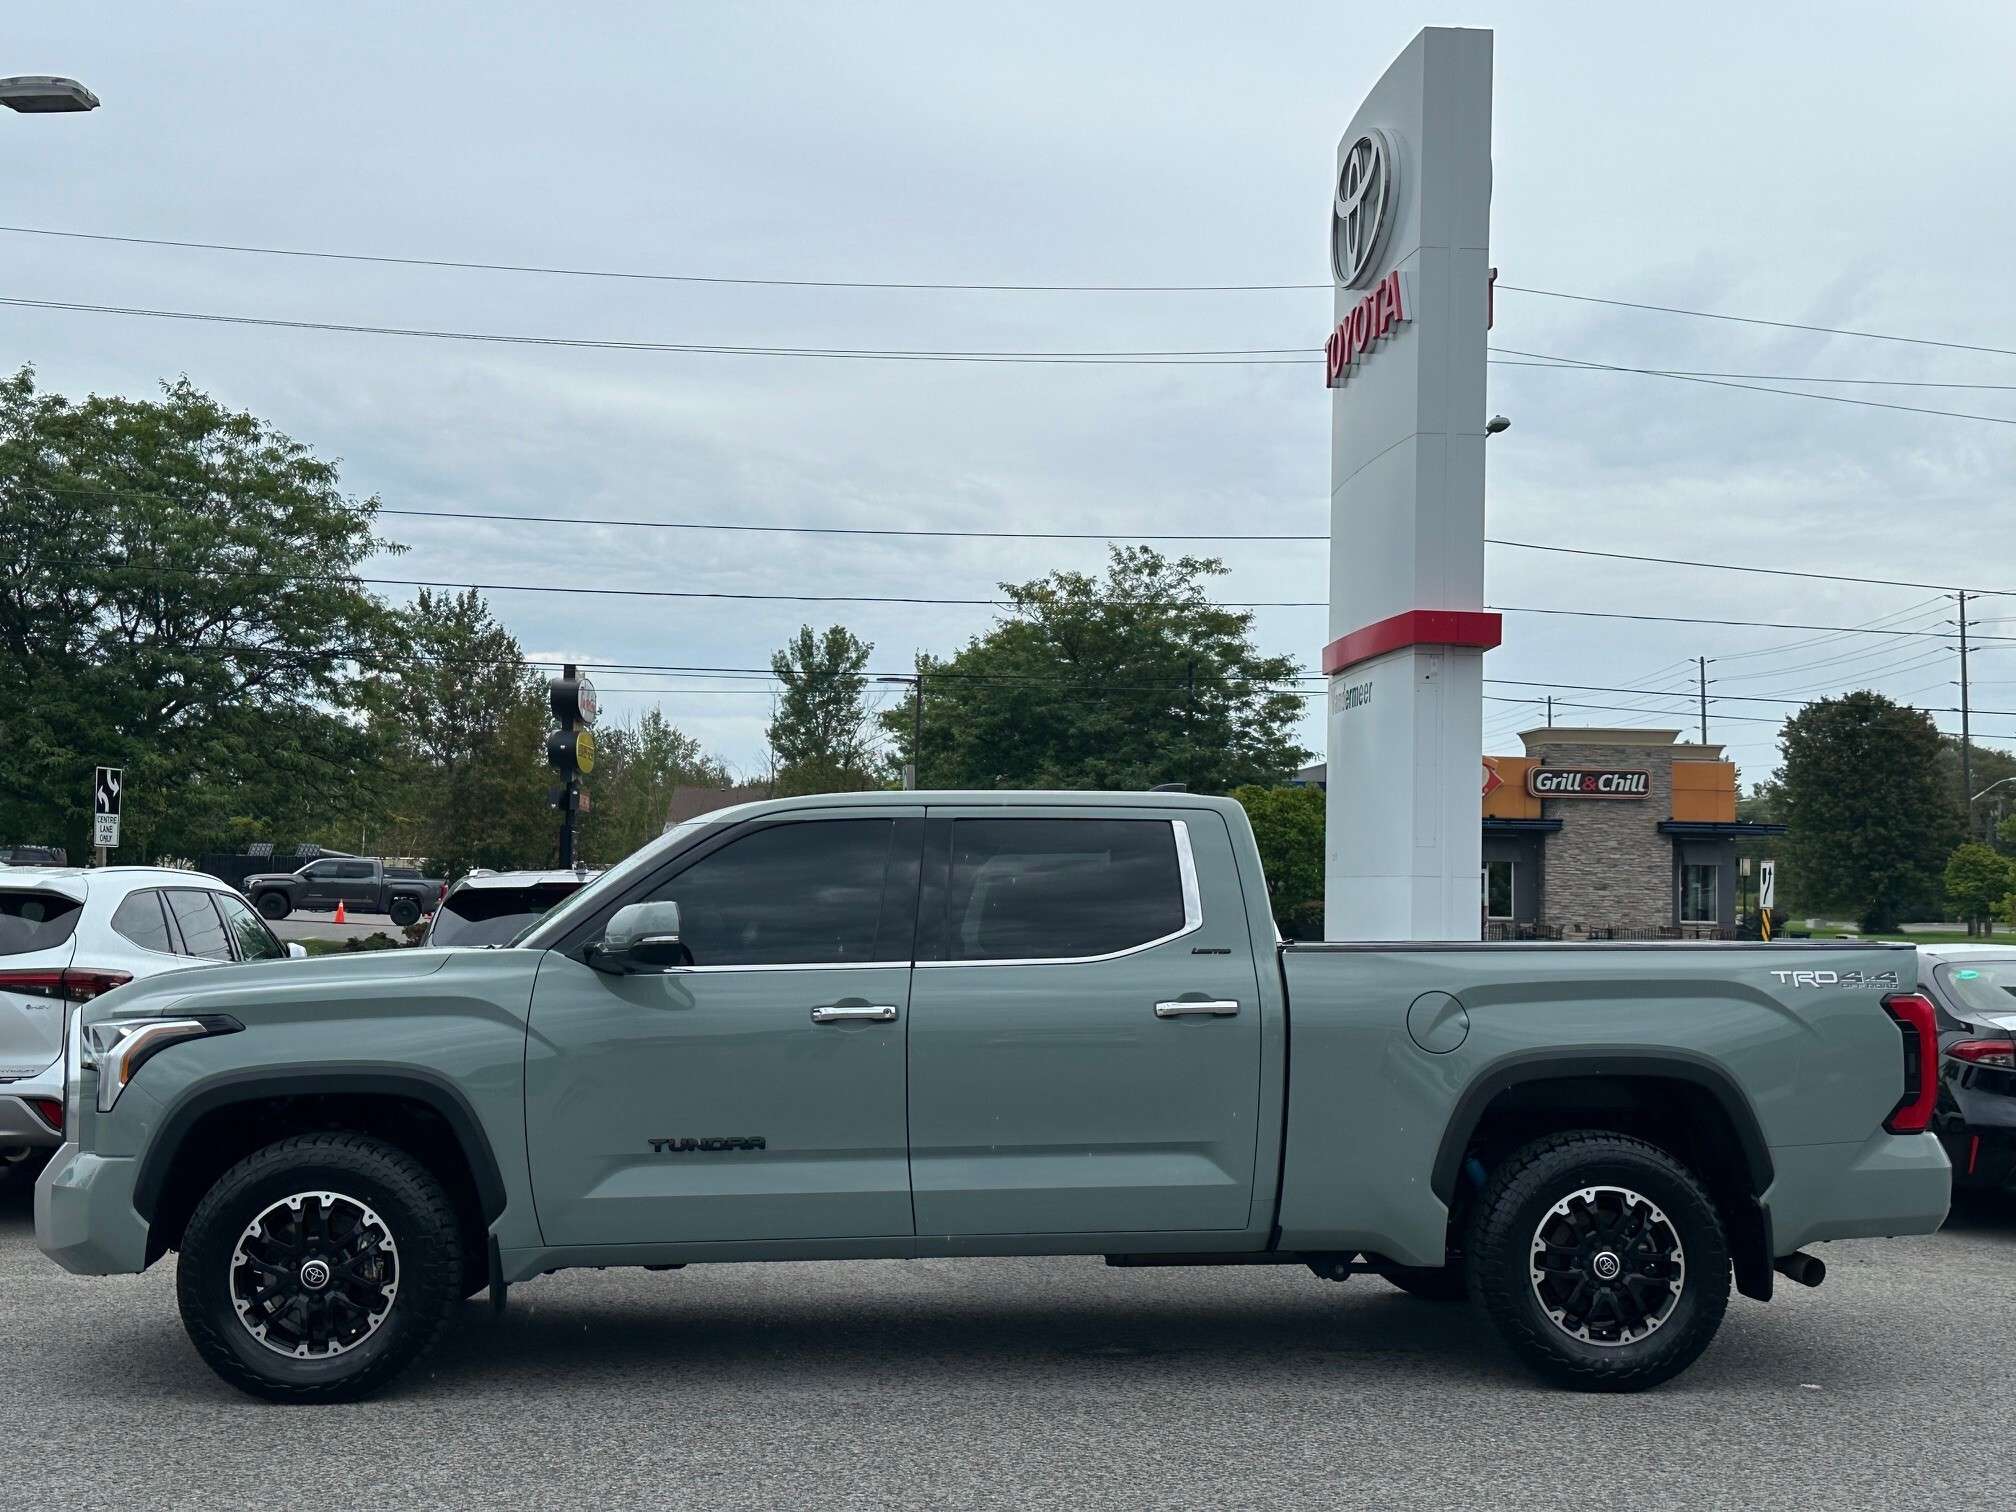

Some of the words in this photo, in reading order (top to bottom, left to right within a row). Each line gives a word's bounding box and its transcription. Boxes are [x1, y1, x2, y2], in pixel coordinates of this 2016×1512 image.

[1325, 270, 1411, 388] TOYOTA
[1331, 681, 1373, 716] dermeer
[1536, 773, 1581, 790] Grill
[1583, 775, 1597, 791] &
[1598, 774, 1646, 791] Chill
[97, 815, 118, 825] CENTRE
[99, 825, 113, 833] LANE
[99, 834, 113, 843] ONLY
[1770, 970, 1838, 987] TRD
[648, 1136, 767, 1153] TUNDRA
